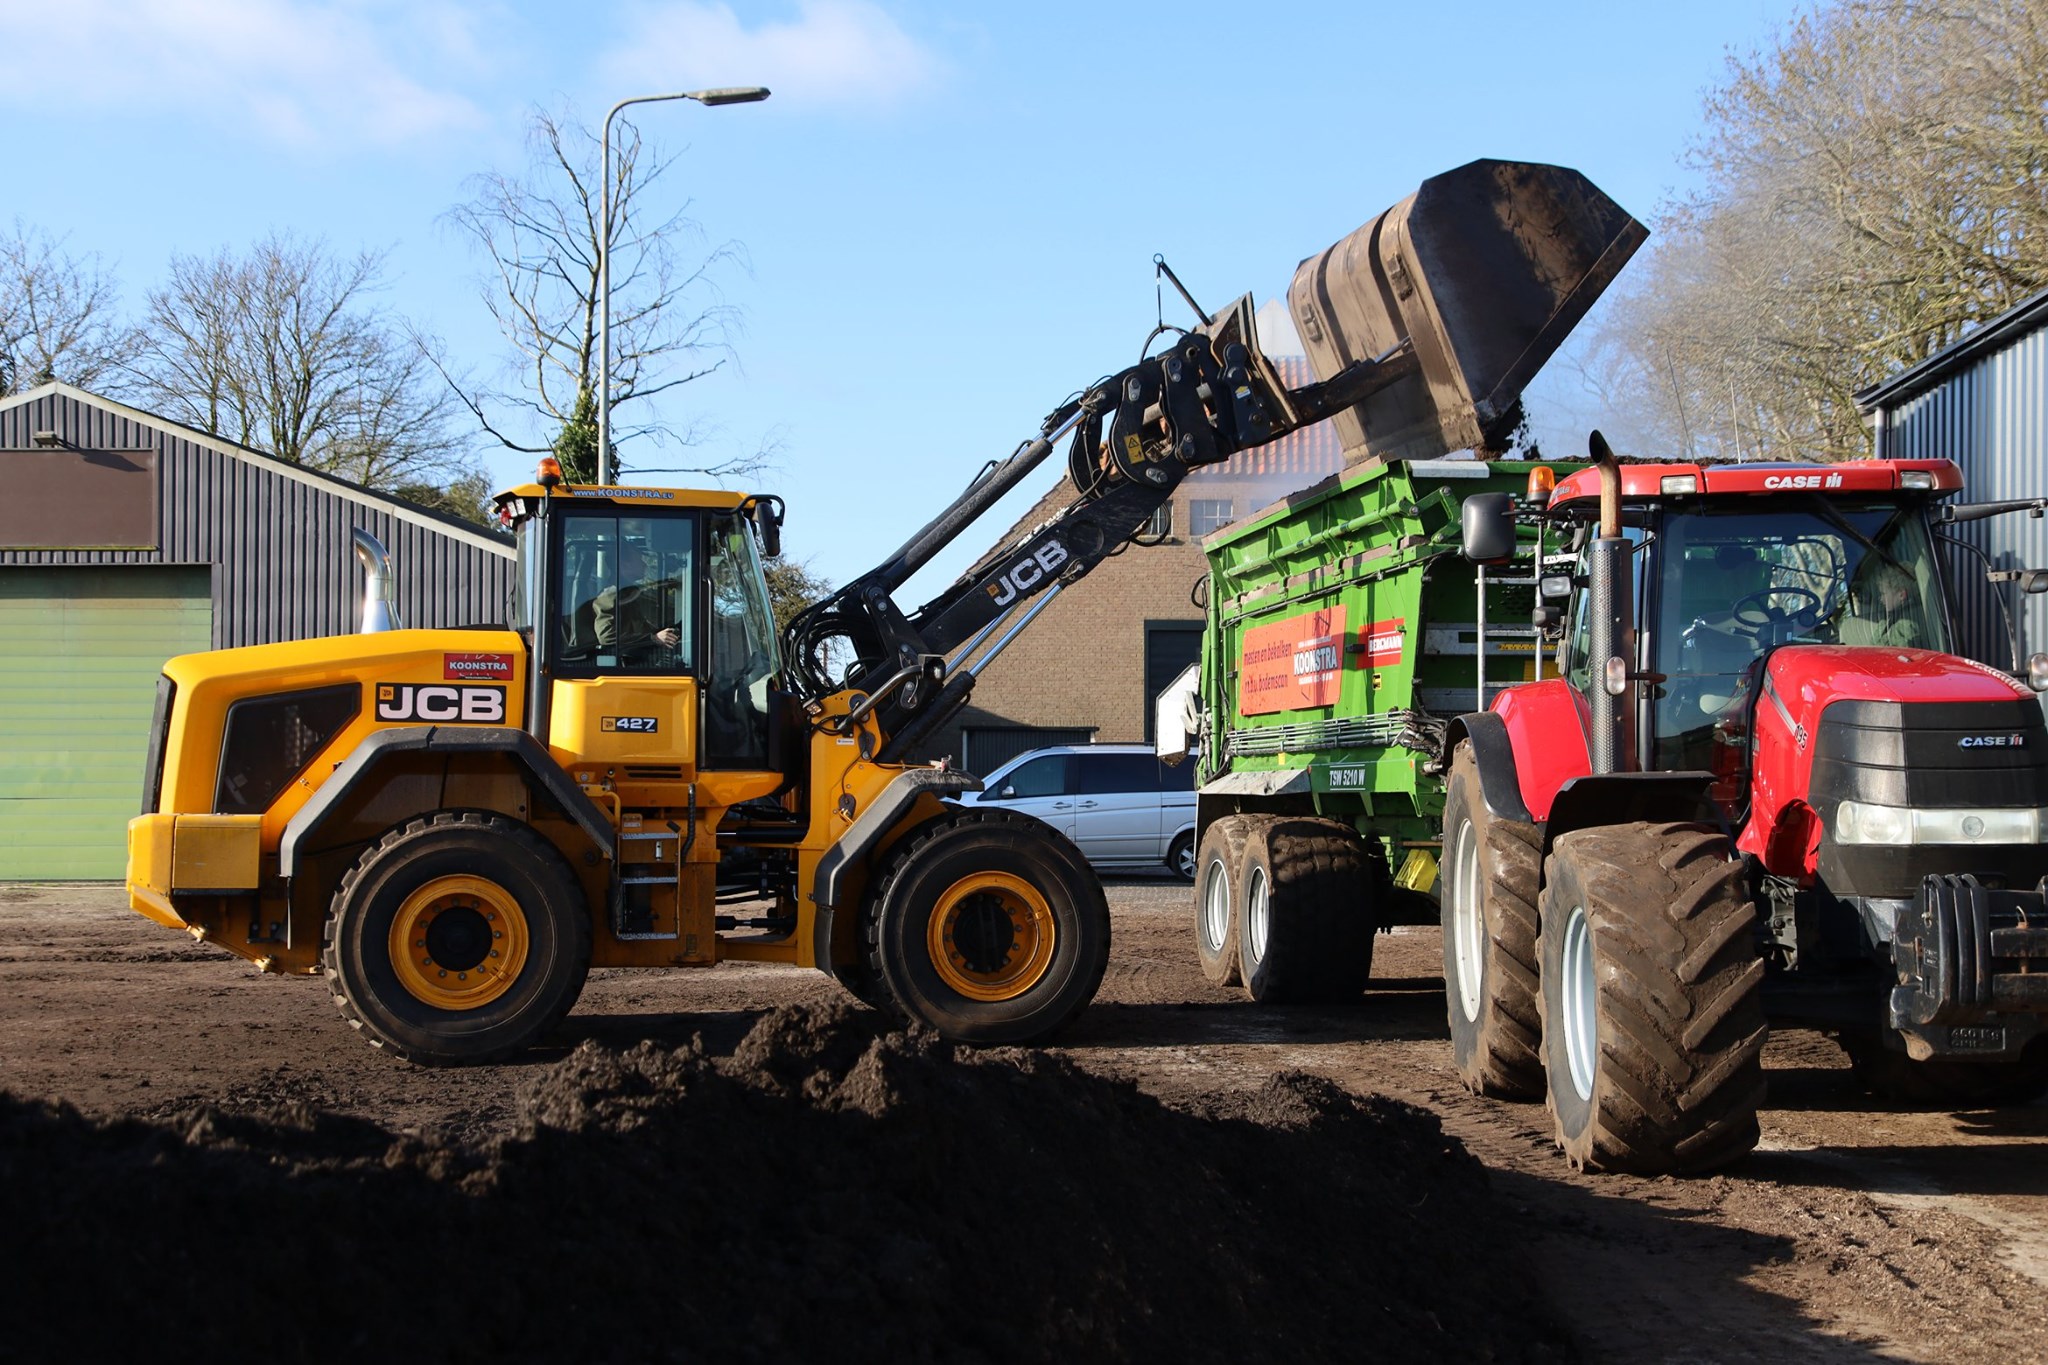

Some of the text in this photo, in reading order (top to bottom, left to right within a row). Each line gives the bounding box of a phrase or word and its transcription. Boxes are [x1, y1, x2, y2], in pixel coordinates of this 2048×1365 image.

[1764, 475, 1822, 489] CASE
[993, 540, 1068, 606] JCB
[1369, 634, 1403, 653] BERGMANN
[449, 661, 508, 671] KOONSTRA
[1293, 645, 1338, 676] KOONSTRA
[378, 686, 504, 721] JCB
[616, 717, 656, 730] 427
[1961, 736, 2006, 747] CASE
[1329, 769, 1343, 786] TSW
[1358, 768, 1366, 786] W
